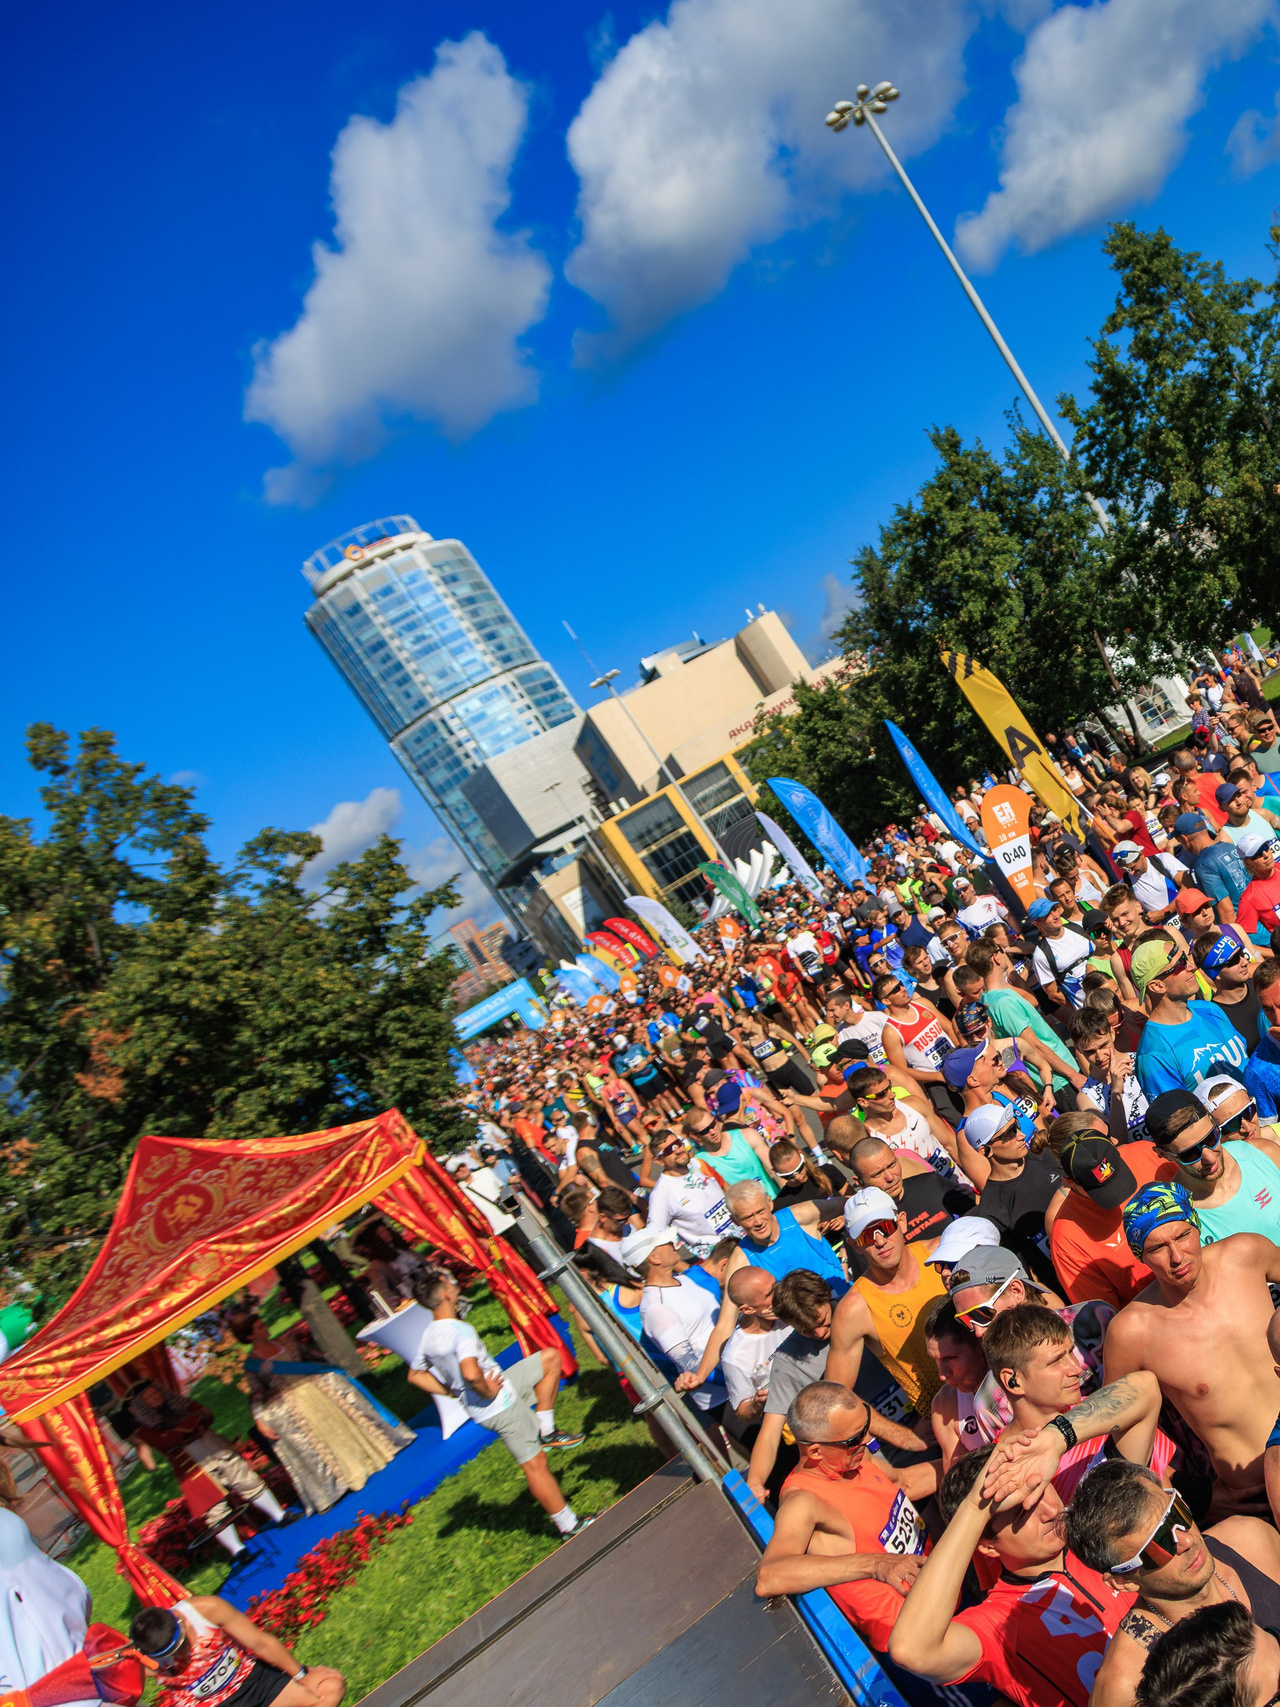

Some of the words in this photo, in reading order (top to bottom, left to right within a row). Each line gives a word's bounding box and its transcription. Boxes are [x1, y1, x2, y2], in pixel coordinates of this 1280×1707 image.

[1004, 725, 1043, 769] A
[998, 833, 1007, 842] 10
[1002, 845, 1027, 864] 0:40
[913, 1021, 943, 1052] RUSSIA
[908, 1211, 930, 1227] THE
[891, 1507, 915, 1554] 5230
[199, 1655, 235, 1694] 6704
